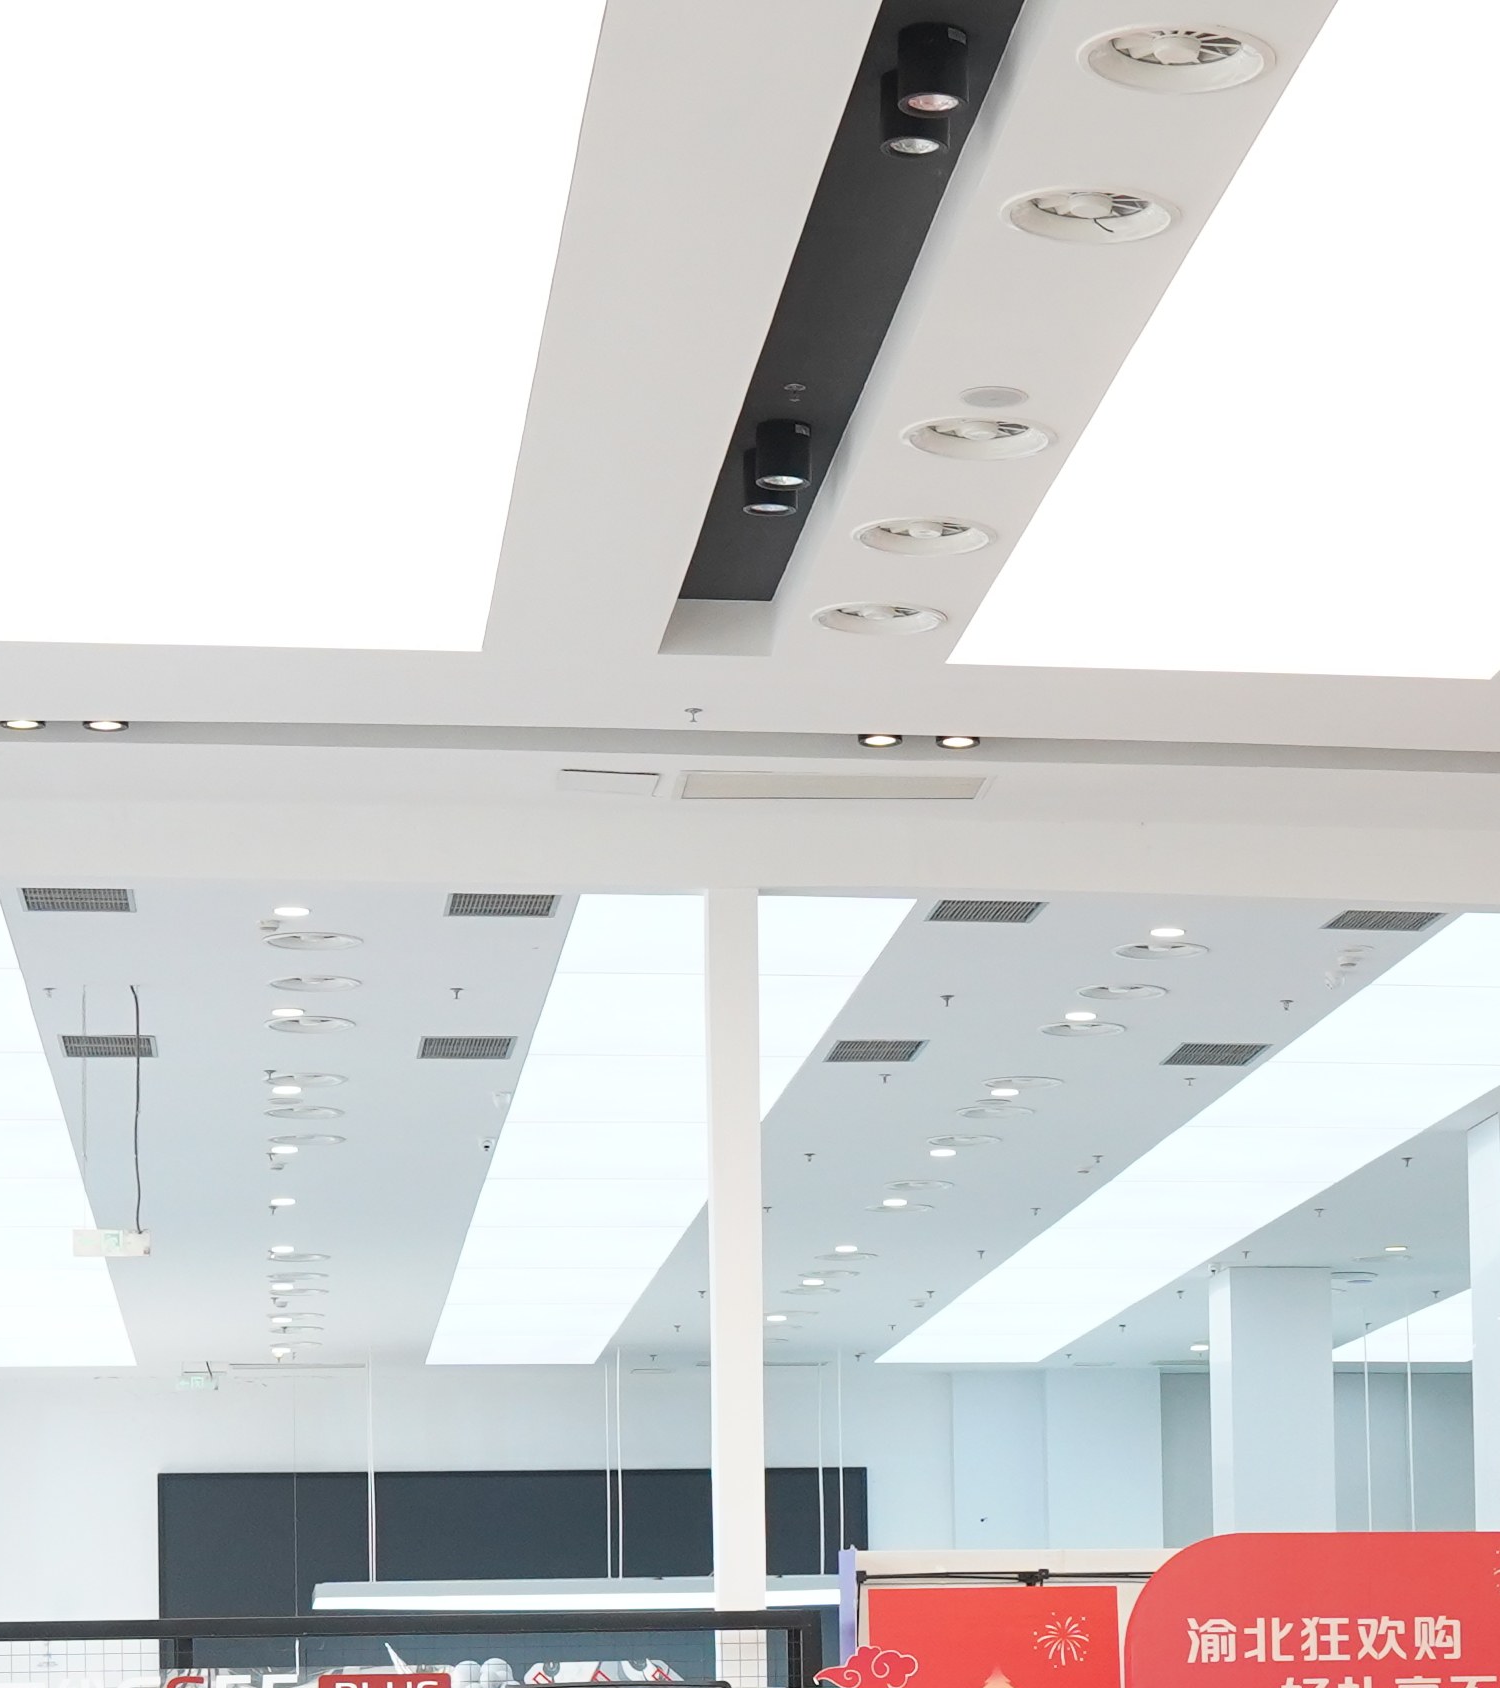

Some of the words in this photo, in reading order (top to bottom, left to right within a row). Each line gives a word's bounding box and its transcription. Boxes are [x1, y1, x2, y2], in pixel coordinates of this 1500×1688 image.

[1186, 1615, 1462, 1663] 渝北狂欢购
